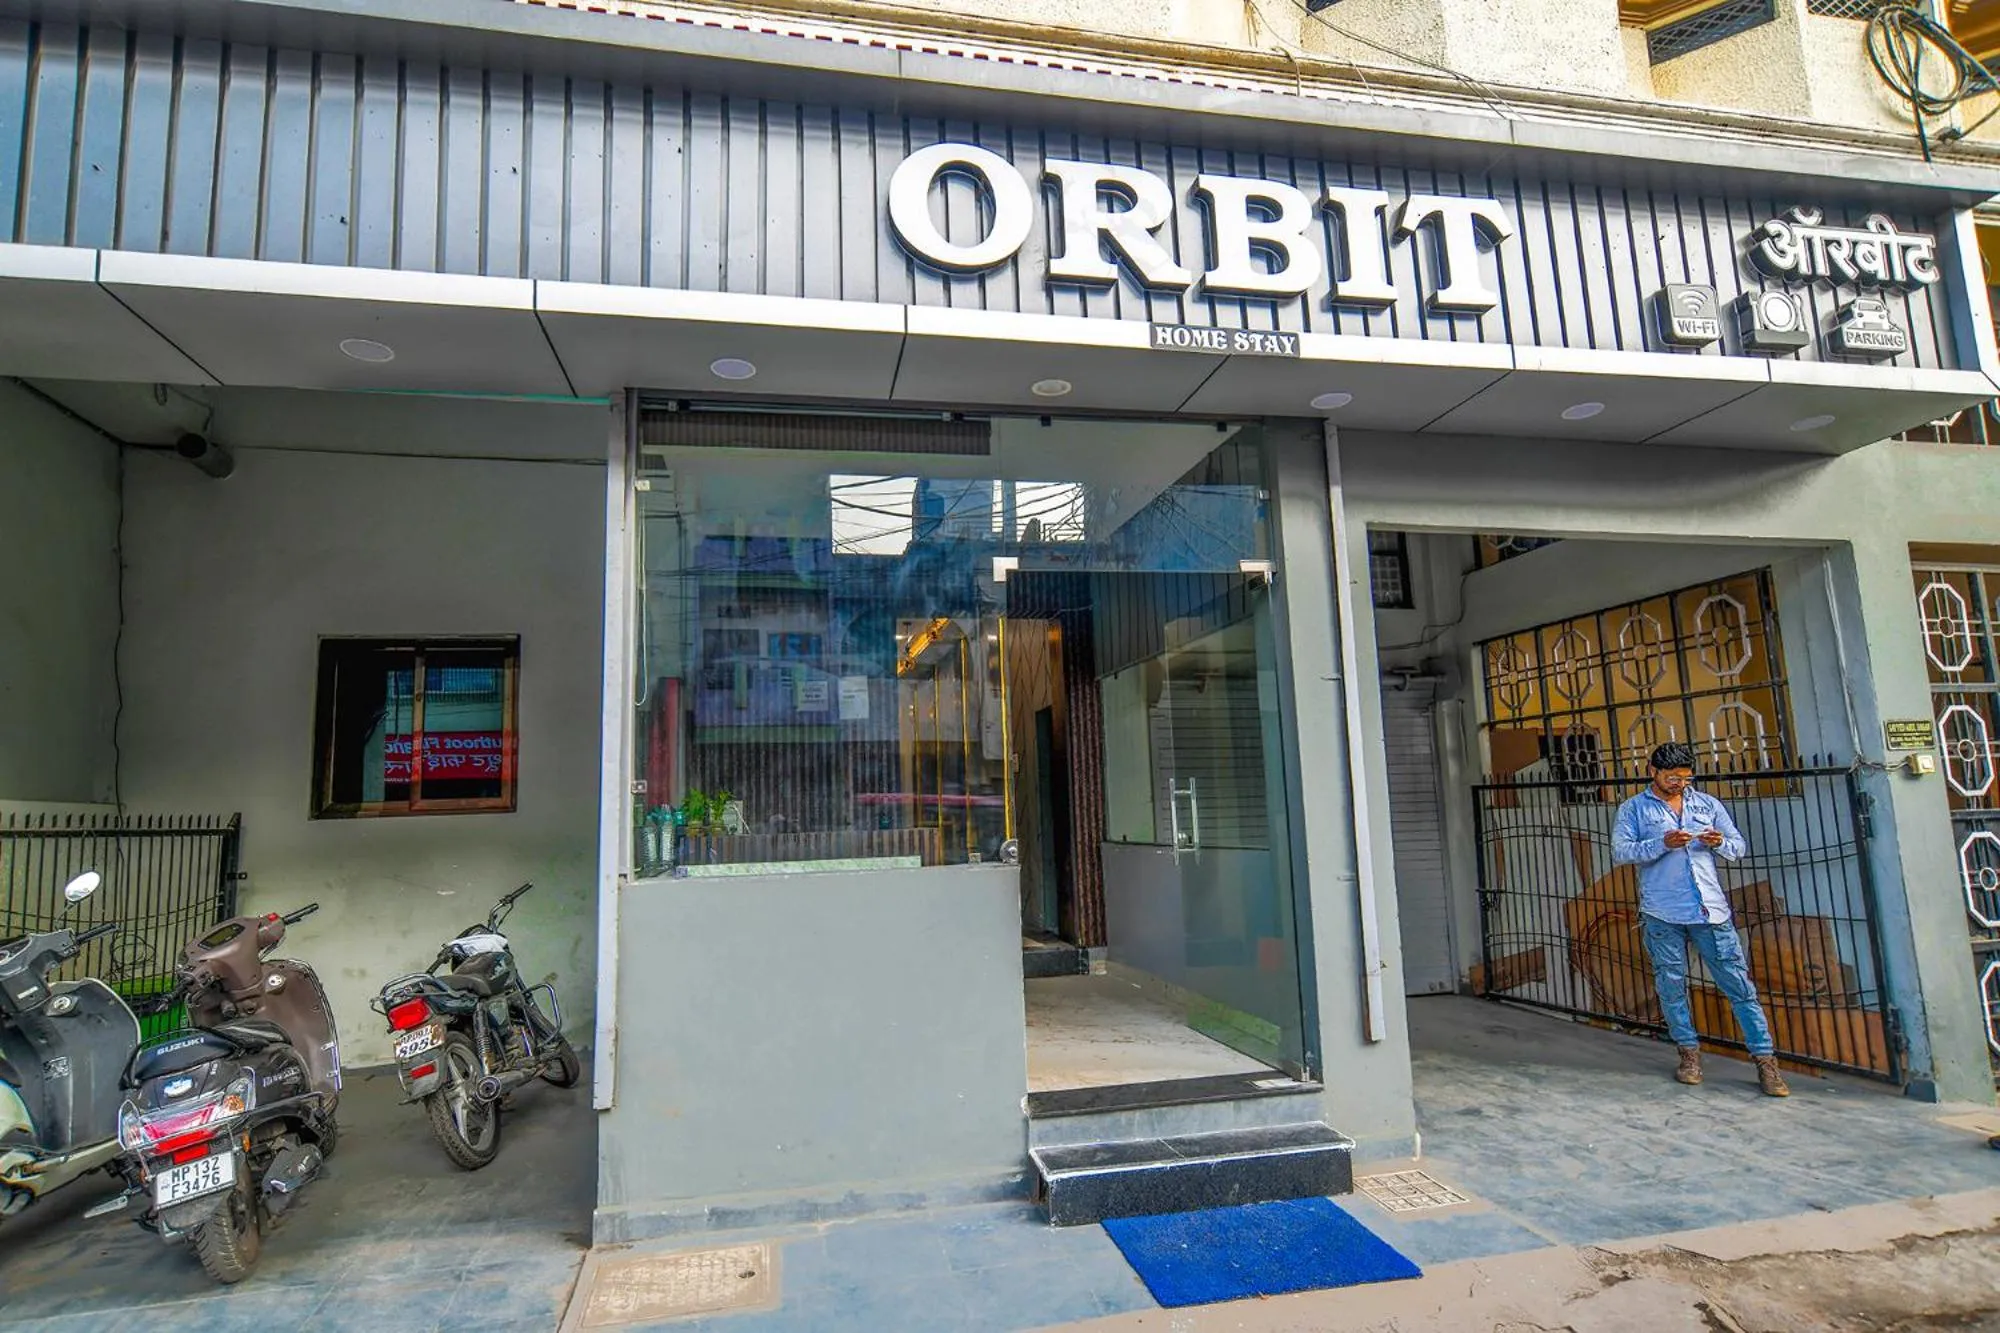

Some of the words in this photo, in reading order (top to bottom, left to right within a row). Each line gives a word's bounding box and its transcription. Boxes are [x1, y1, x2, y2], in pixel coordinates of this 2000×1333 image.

[888, 142, 1514, 310] ORBIT
[1760, 207, 1941, 283] ऑरबीट
[1155, 326, 1228, 350] HOME
[1234, 332, 1296, 354] STAY
[1845, 331, 1905, 347] PARKING
[156, 1037, 205, 1056] SUZUKI
[171, 1171, 220, 1199] F3476
